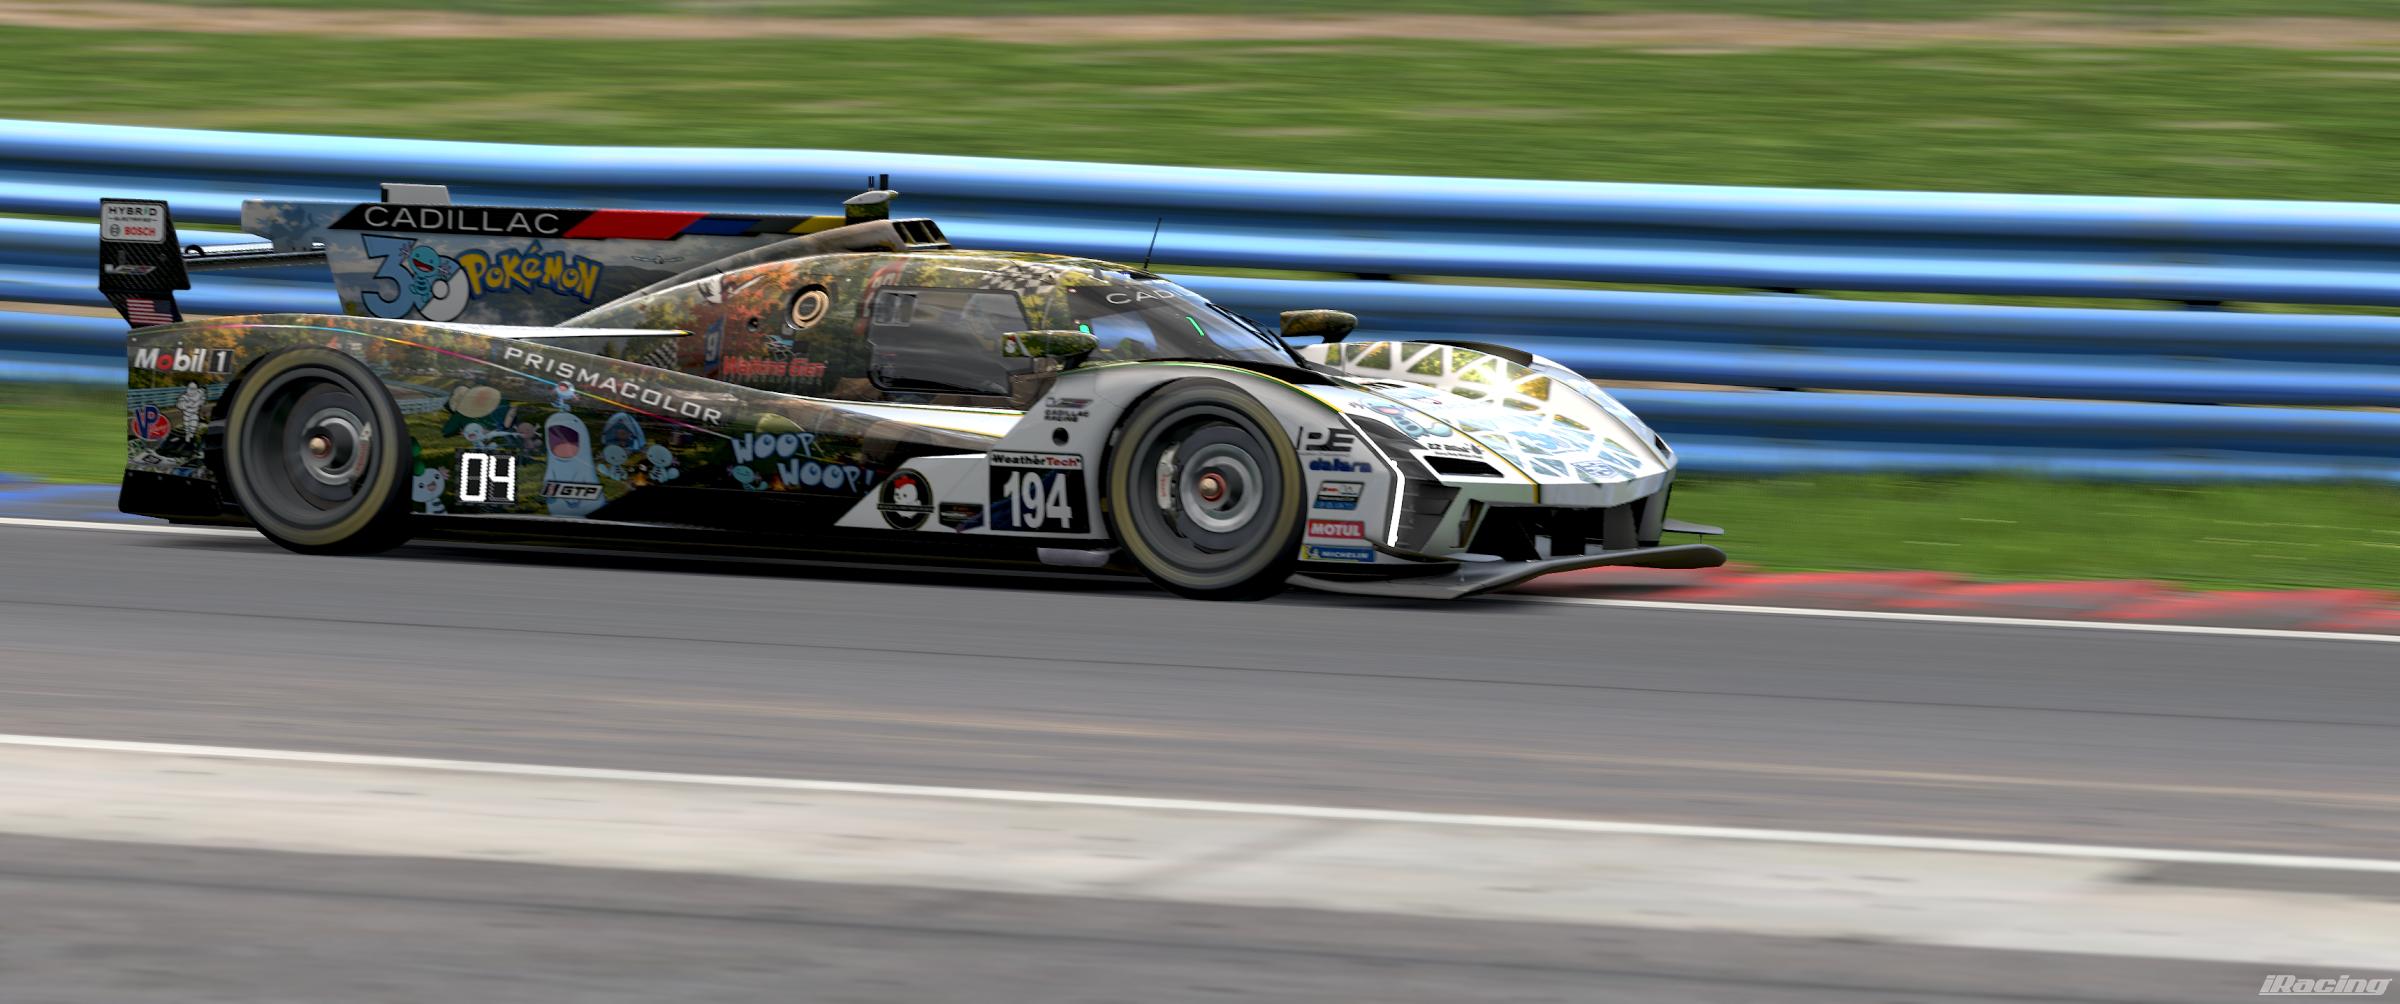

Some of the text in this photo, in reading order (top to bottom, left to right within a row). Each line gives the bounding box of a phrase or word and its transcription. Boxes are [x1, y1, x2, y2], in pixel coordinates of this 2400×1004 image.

[108, 206, 158, 216] HYBRID
[364, 206, 559, 234] CADILLAC
[123, 226, 156, 237] BOSCH
[133, 347, 205, 373] Mobil
[503, 345, 724, 426] PRISMACOLOR
[730, 431, 817, 465] WOOP
[992, 454, 1078, 467] WeatherTech
[459, 452, 516, 502] 04
[560, 486, 598, 497] GTP
[1003, 471, 1072, 529] 194
[1311, 522, 1361, 537] MOTUL
[1321, 550, 1369, 559] MICHELIN
